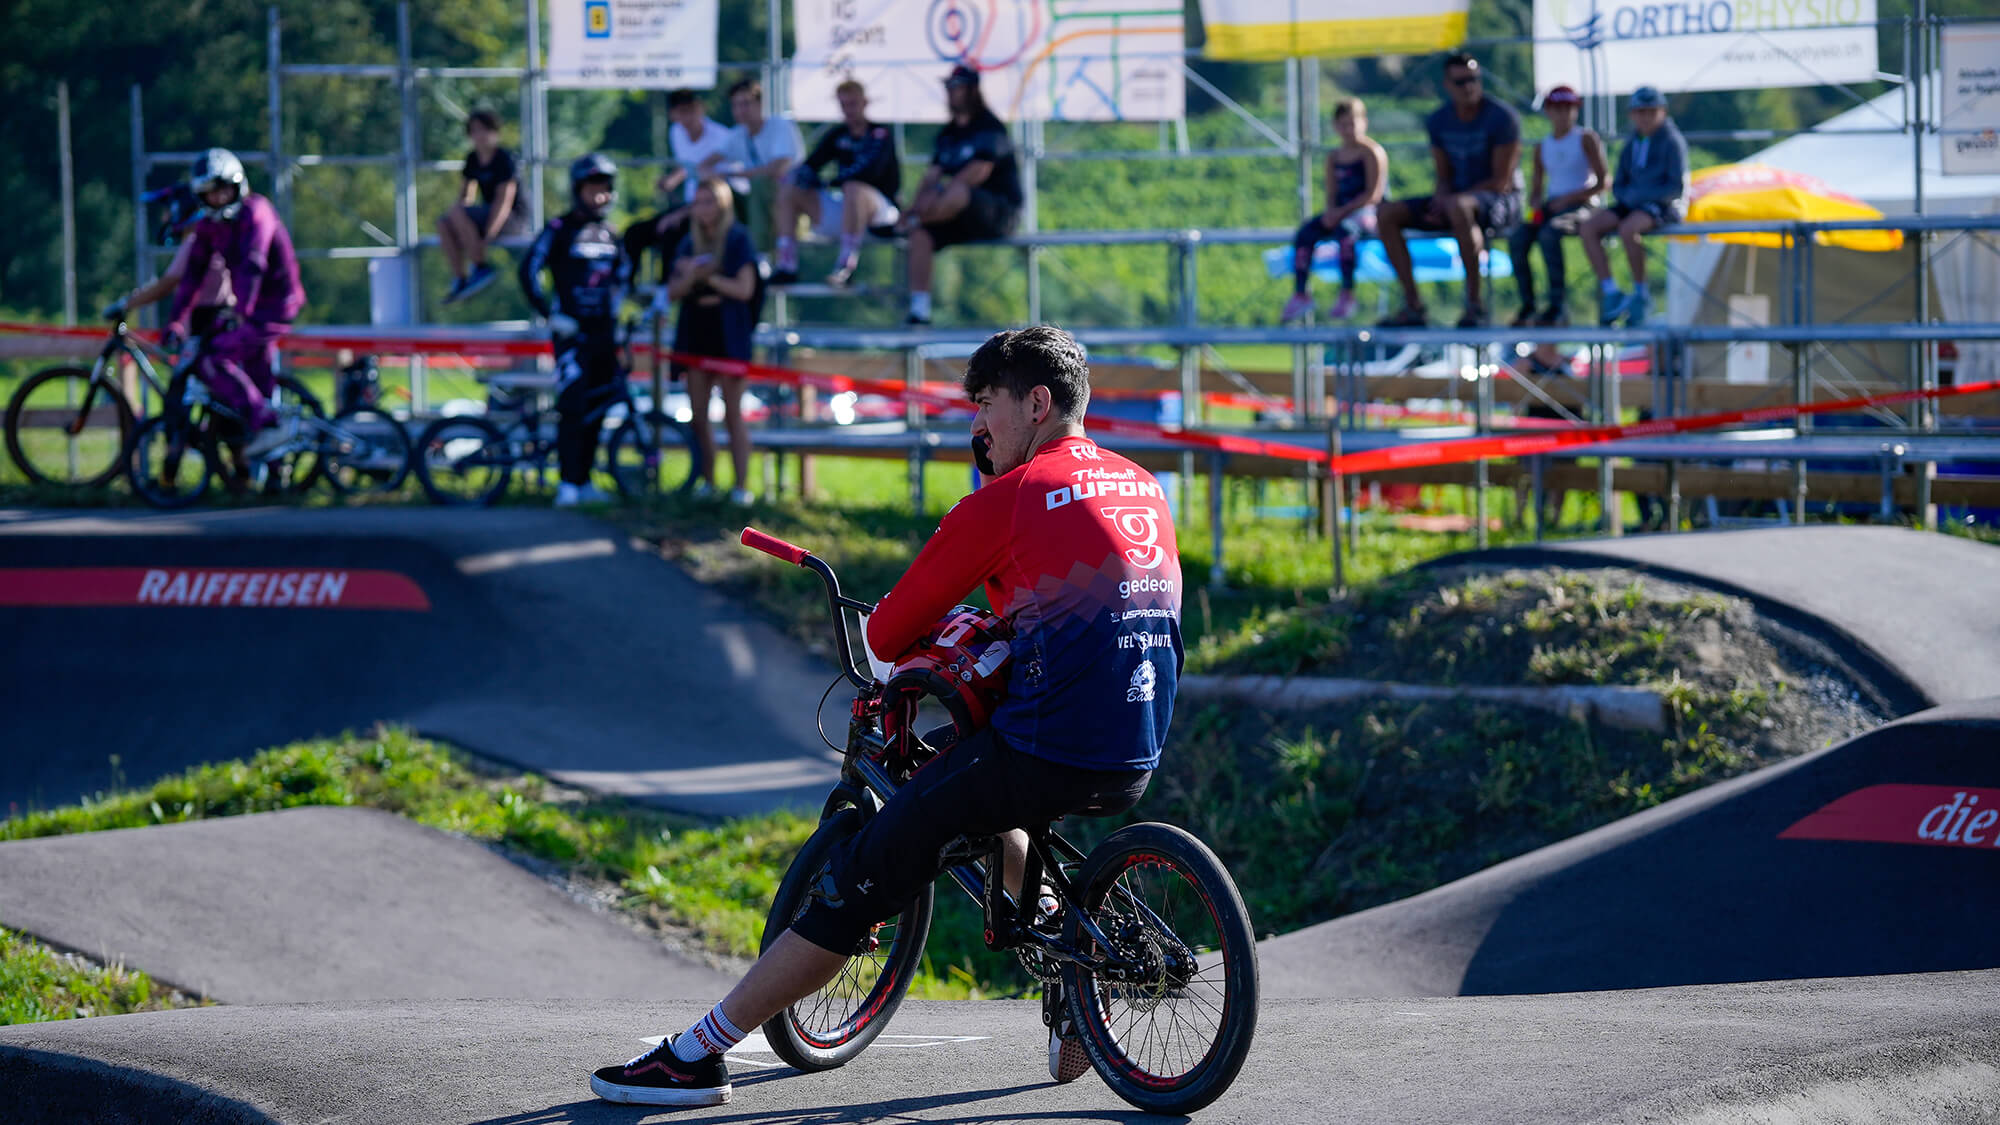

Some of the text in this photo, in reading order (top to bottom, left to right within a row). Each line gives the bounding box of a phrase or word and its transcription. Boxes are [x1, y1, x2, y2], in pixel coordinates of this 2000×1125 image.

[1071, 467, 1137, 481] Thibault
[1045, 481, 1165, 511] DUPONT
[137, 569, 348, 606] RAIFFEISEN
[1118, 574, 1174, 599] gedeon
